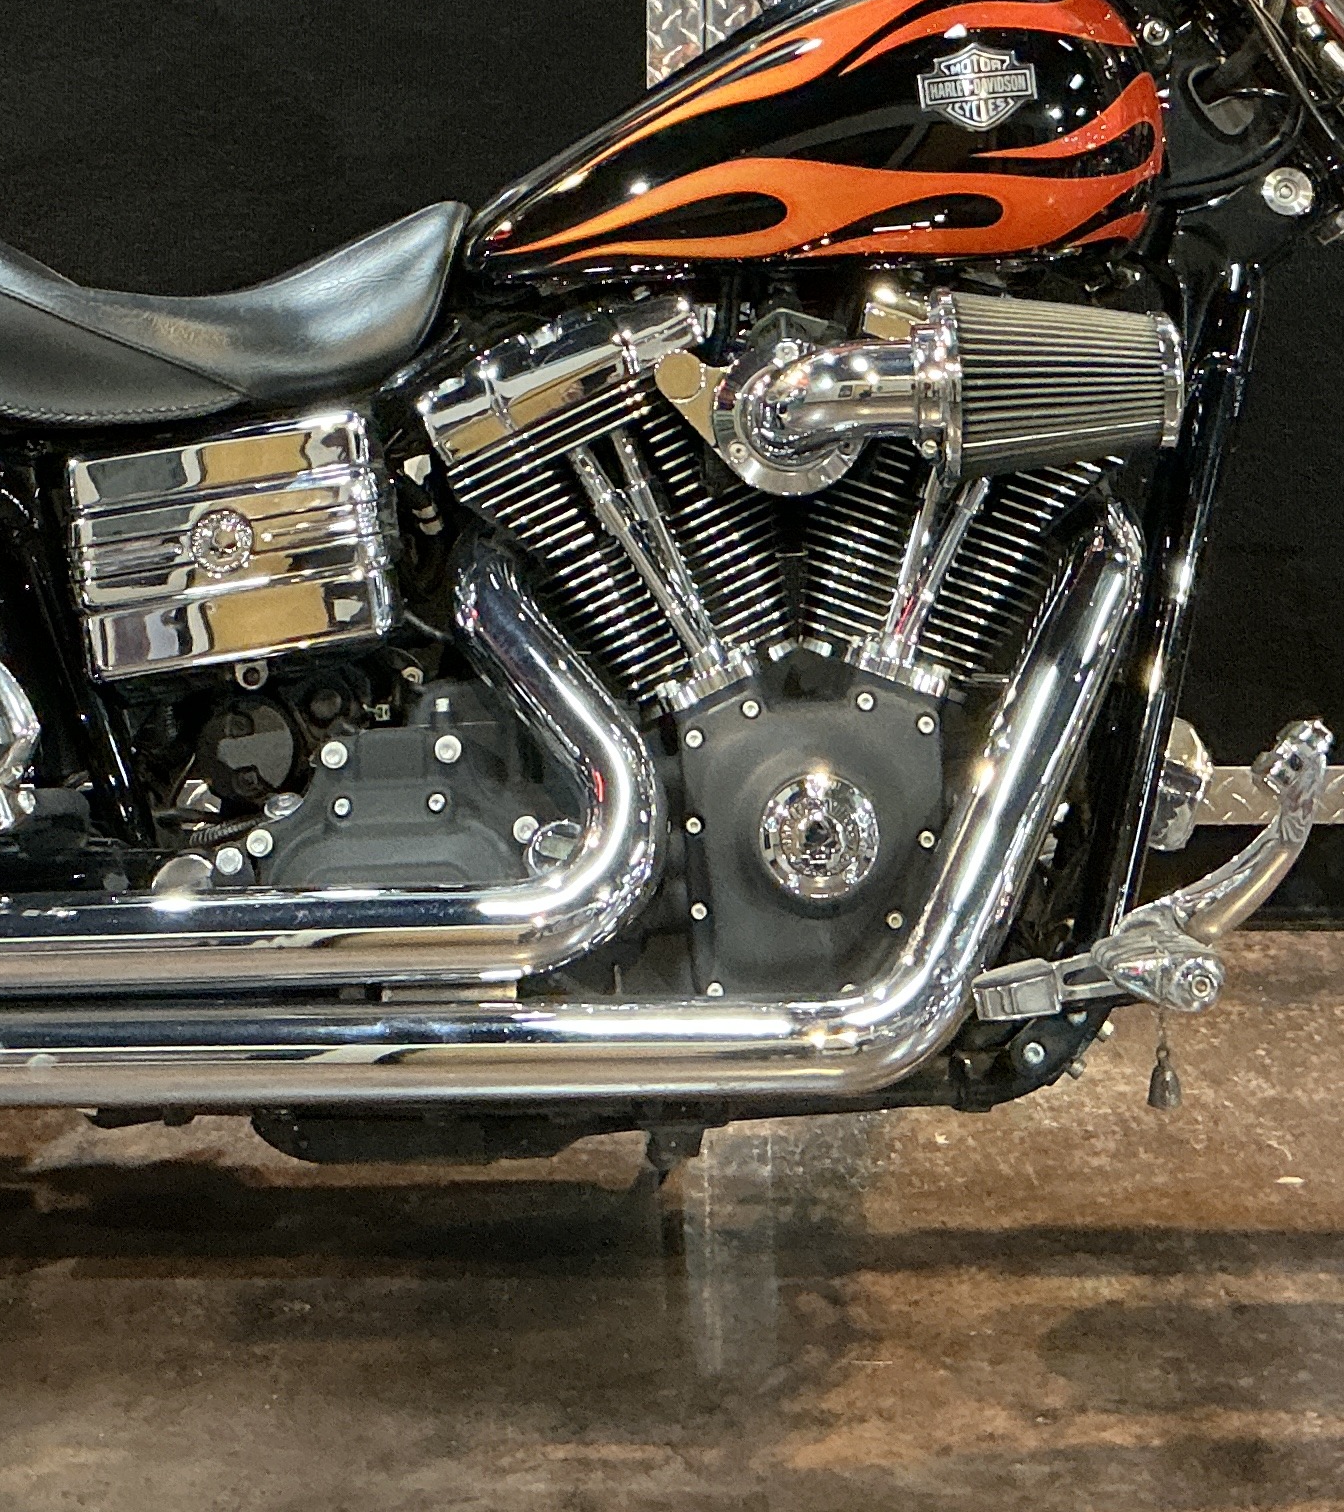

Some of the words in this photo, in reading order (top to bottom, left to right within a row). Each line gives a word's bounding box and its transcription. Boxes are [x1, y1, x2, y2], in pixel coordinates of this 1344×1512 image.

[949, 54, 1002, 76] MOTOR
[928, 74, 1027, 100] HARLEY-DAVIDSON
[954, 98, 1007, 122] CYCLES
